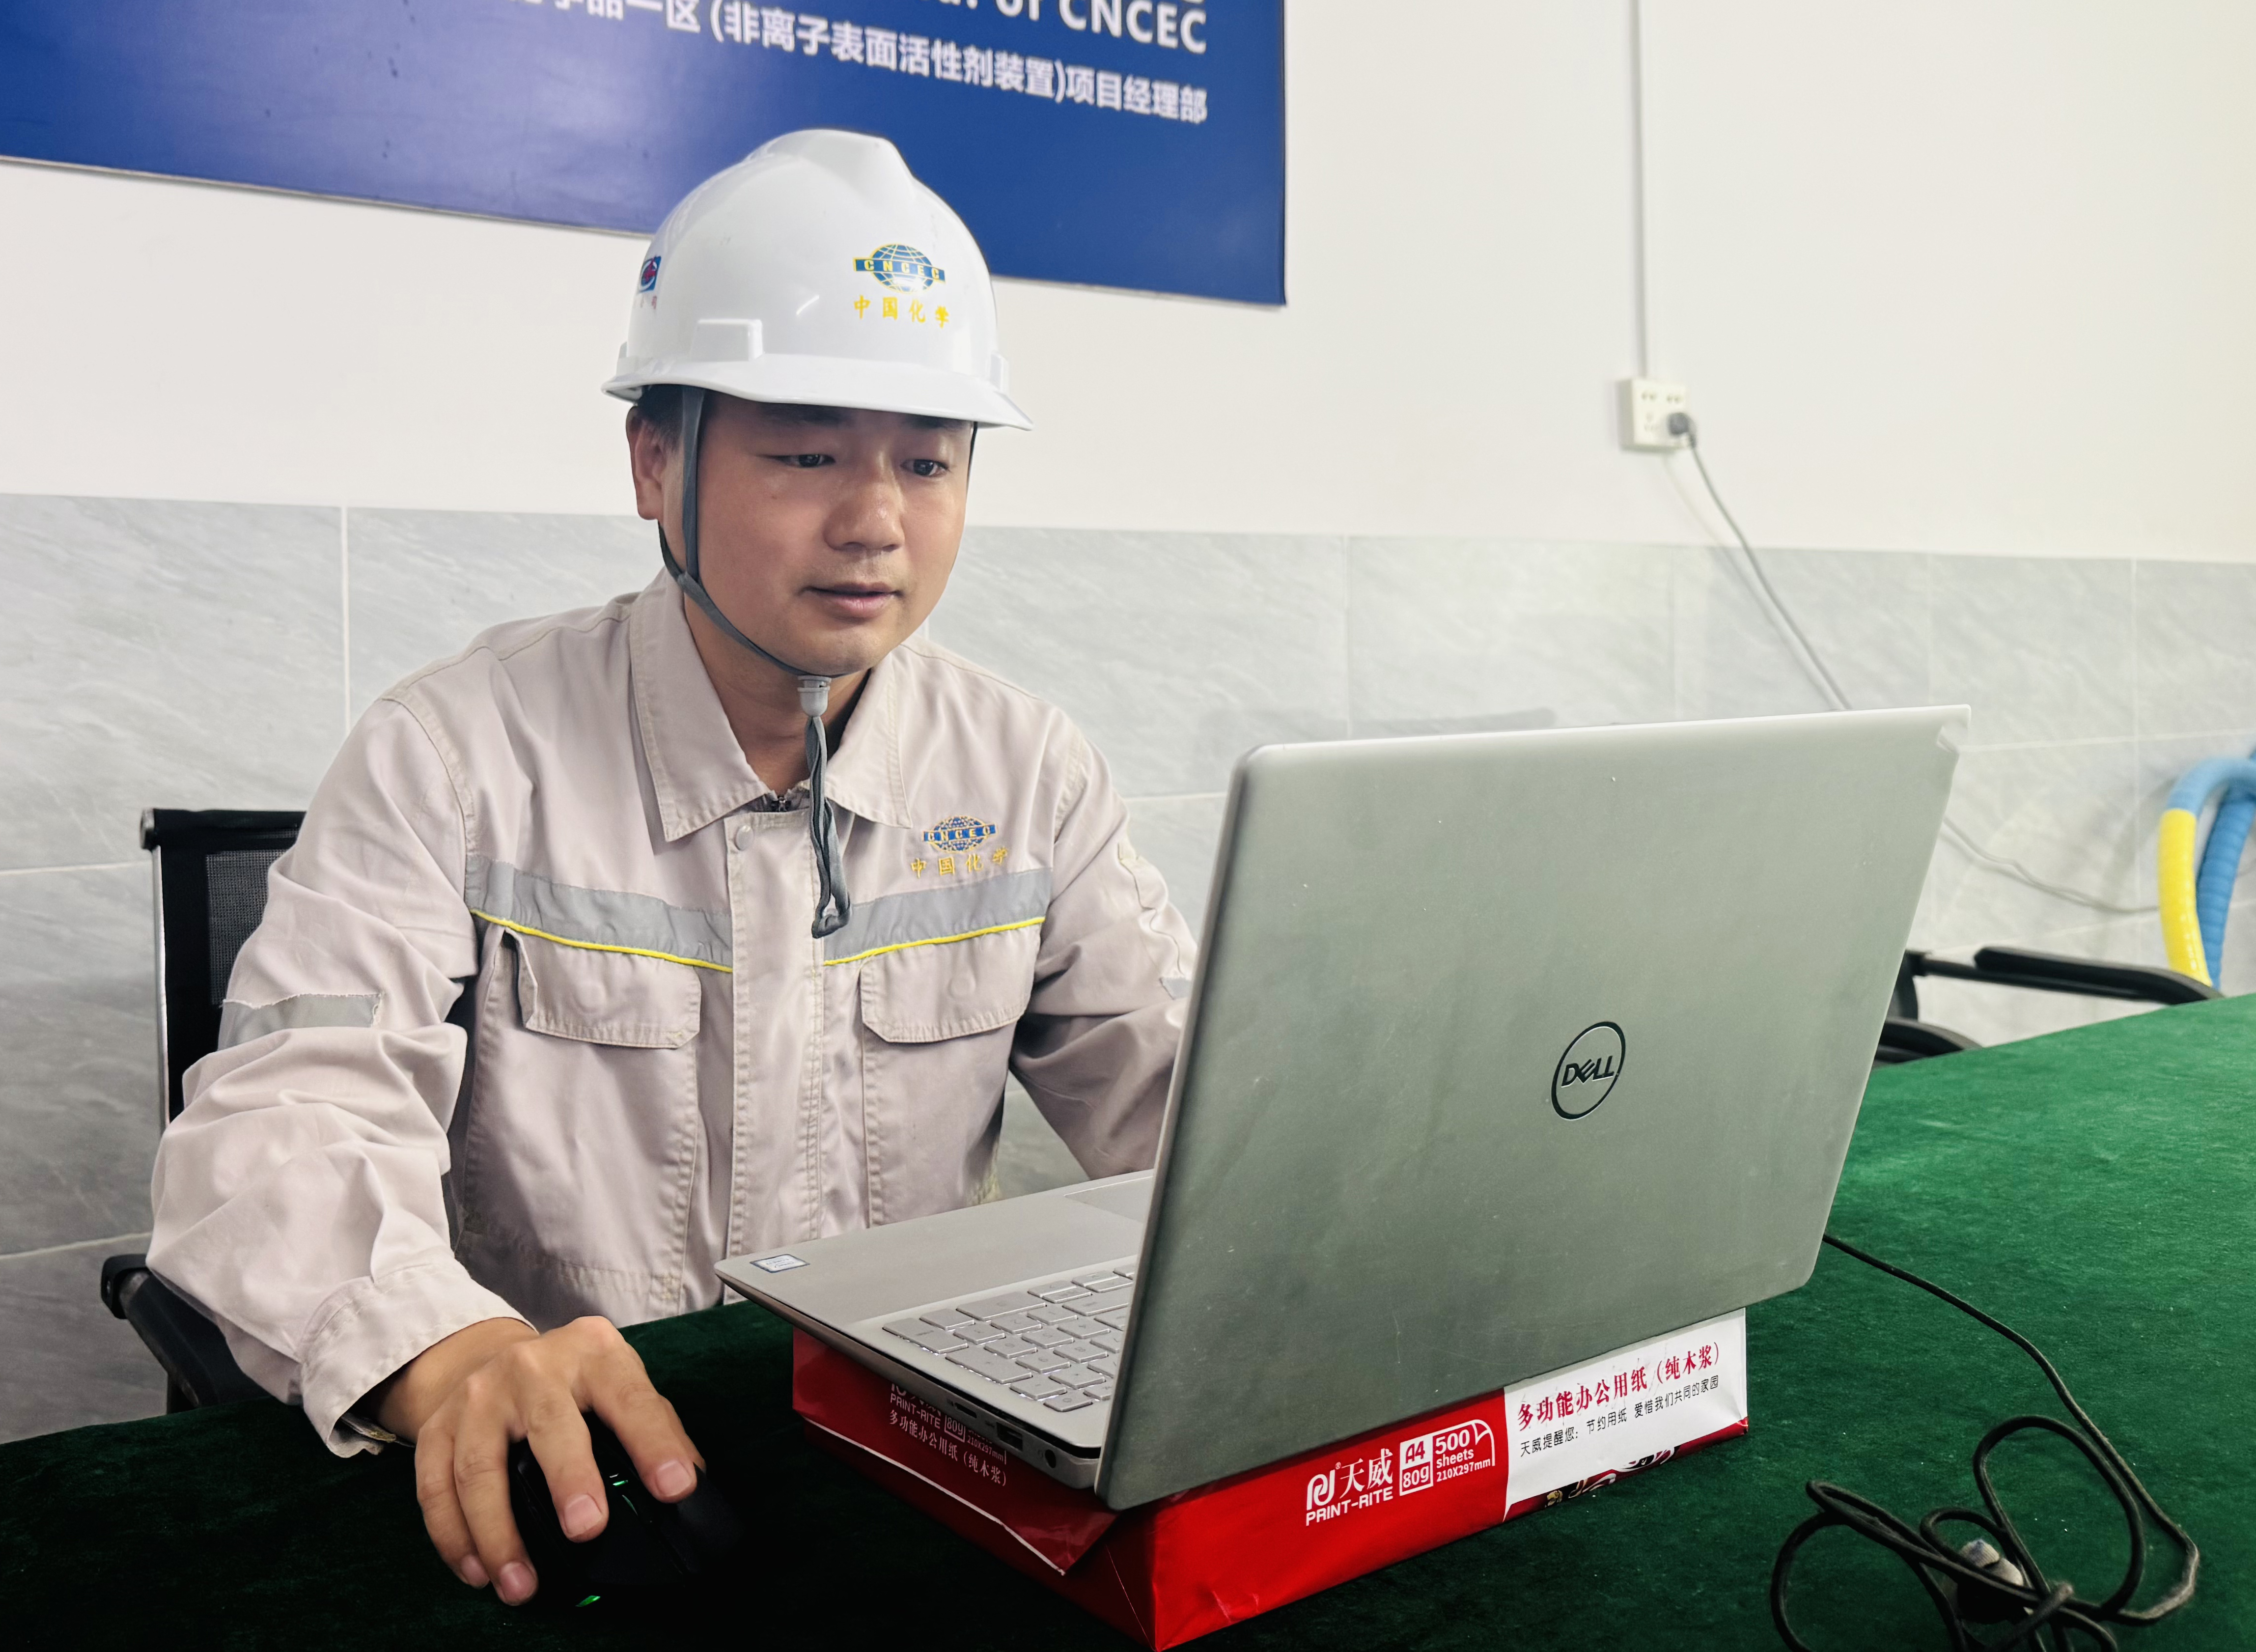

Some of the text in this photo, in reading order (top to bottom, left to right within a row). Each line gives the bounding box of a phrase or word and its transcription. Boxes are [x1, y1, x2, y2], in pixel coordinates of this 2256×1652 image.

[1059, 0, 1207, 54] CNCEC
[863, 259, 940, 280] CNCEC
[854, 295, 949, 328] 中国化学
[911, 845, 1007, 878] 中国化学
[1560, 1055, 1615, 1087] DELL
[890, 1393, 941, 1429] PRINT-RITE
[1587, 1408, 1627, 1434] 节约用纸
[1634, 1375, 1719, 1418] 爱惜我们共同的家园
[1405, 1440, 1426, 1464] A4
[1435, 1428, 1470, 1455] 500
[1339, 1448, 1393, 1499] 天威
[1436, 1448, 1475, 1469] sheets
[1436, 1458, 1491, 1483] 210X297mm
[1402, 1466, 1430, 1488] 80g
[1306, 1486, 1393, 1526] PRINT-RITE
